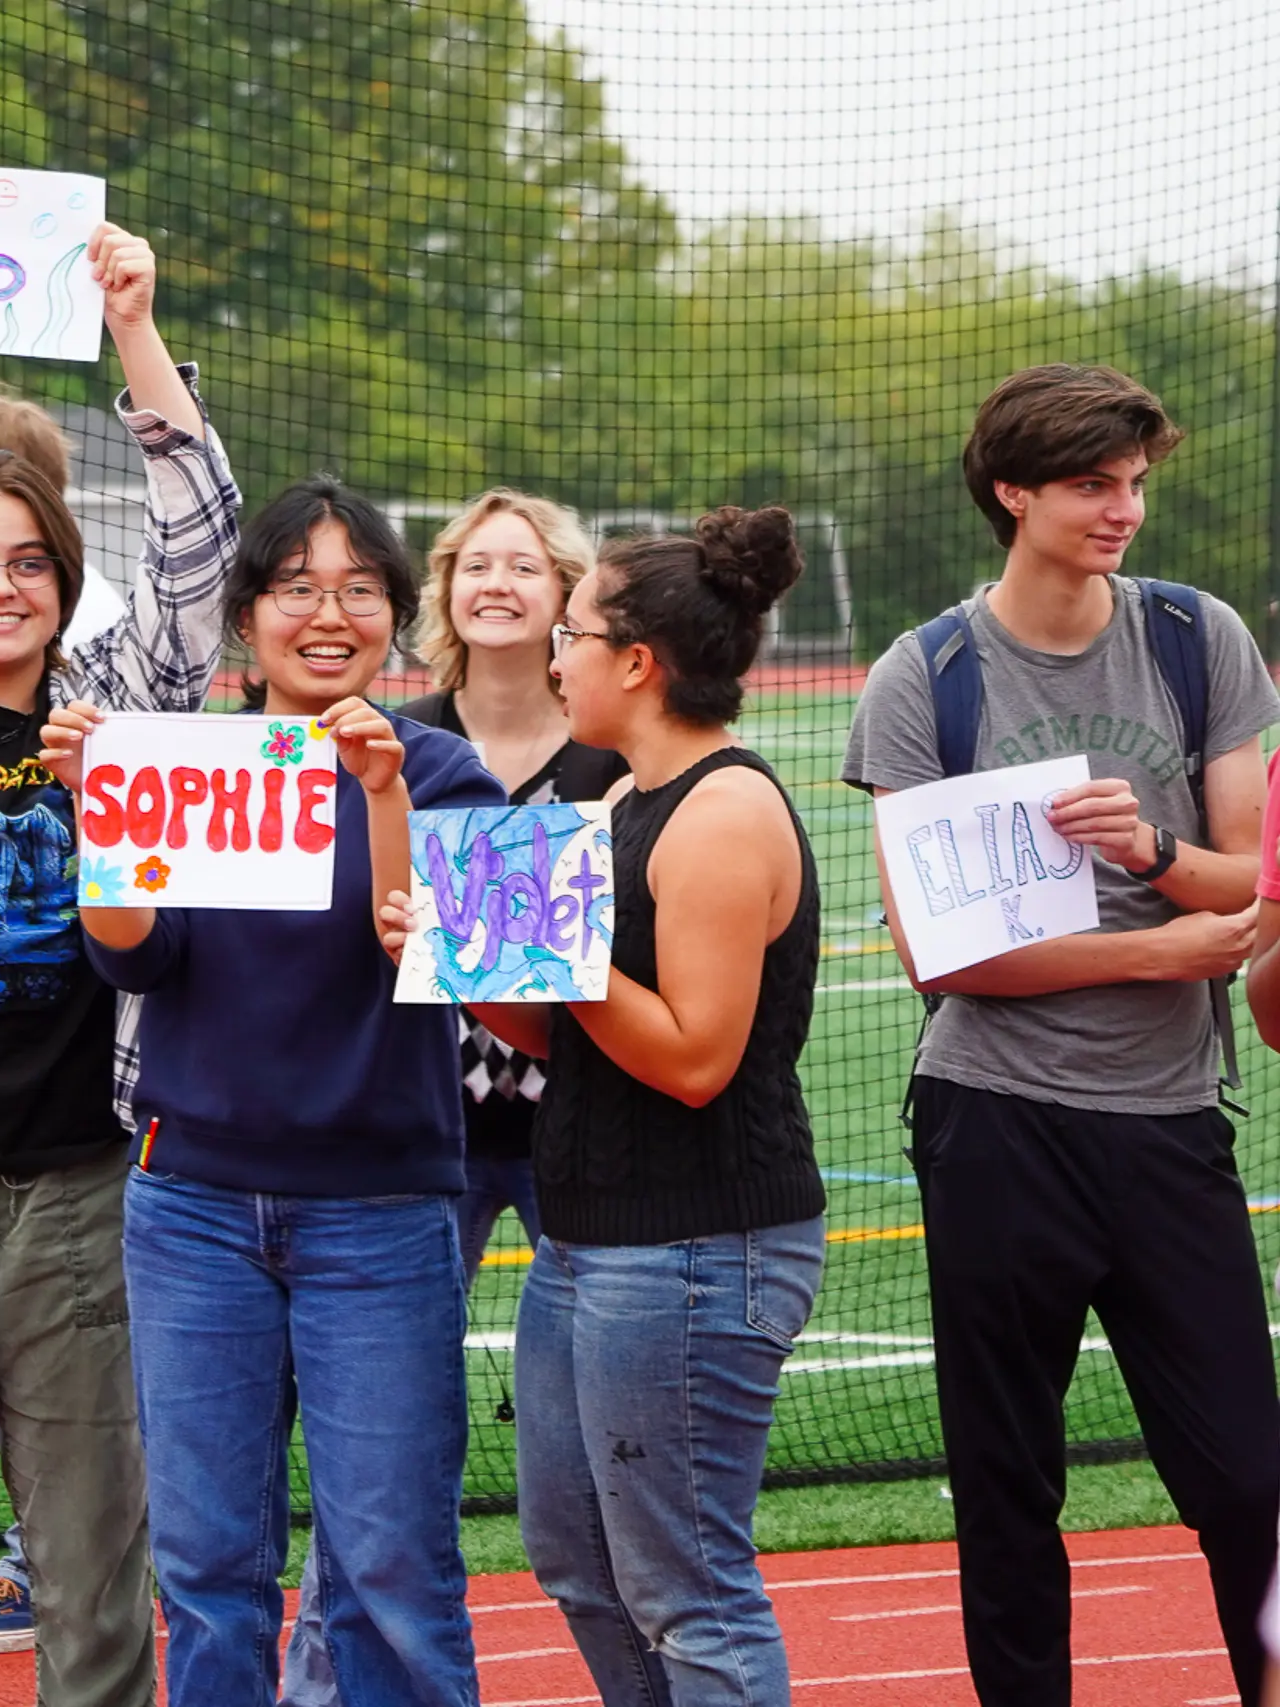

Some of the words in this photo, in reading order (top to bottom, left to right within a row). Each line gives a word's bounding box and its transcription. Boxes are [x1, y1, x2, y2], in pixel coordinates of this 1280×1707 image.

[83, 763, 337, 854] SOPHIE
[425, 821, 607, 972] Violet
[1000, 894, 1045, 944] K.
